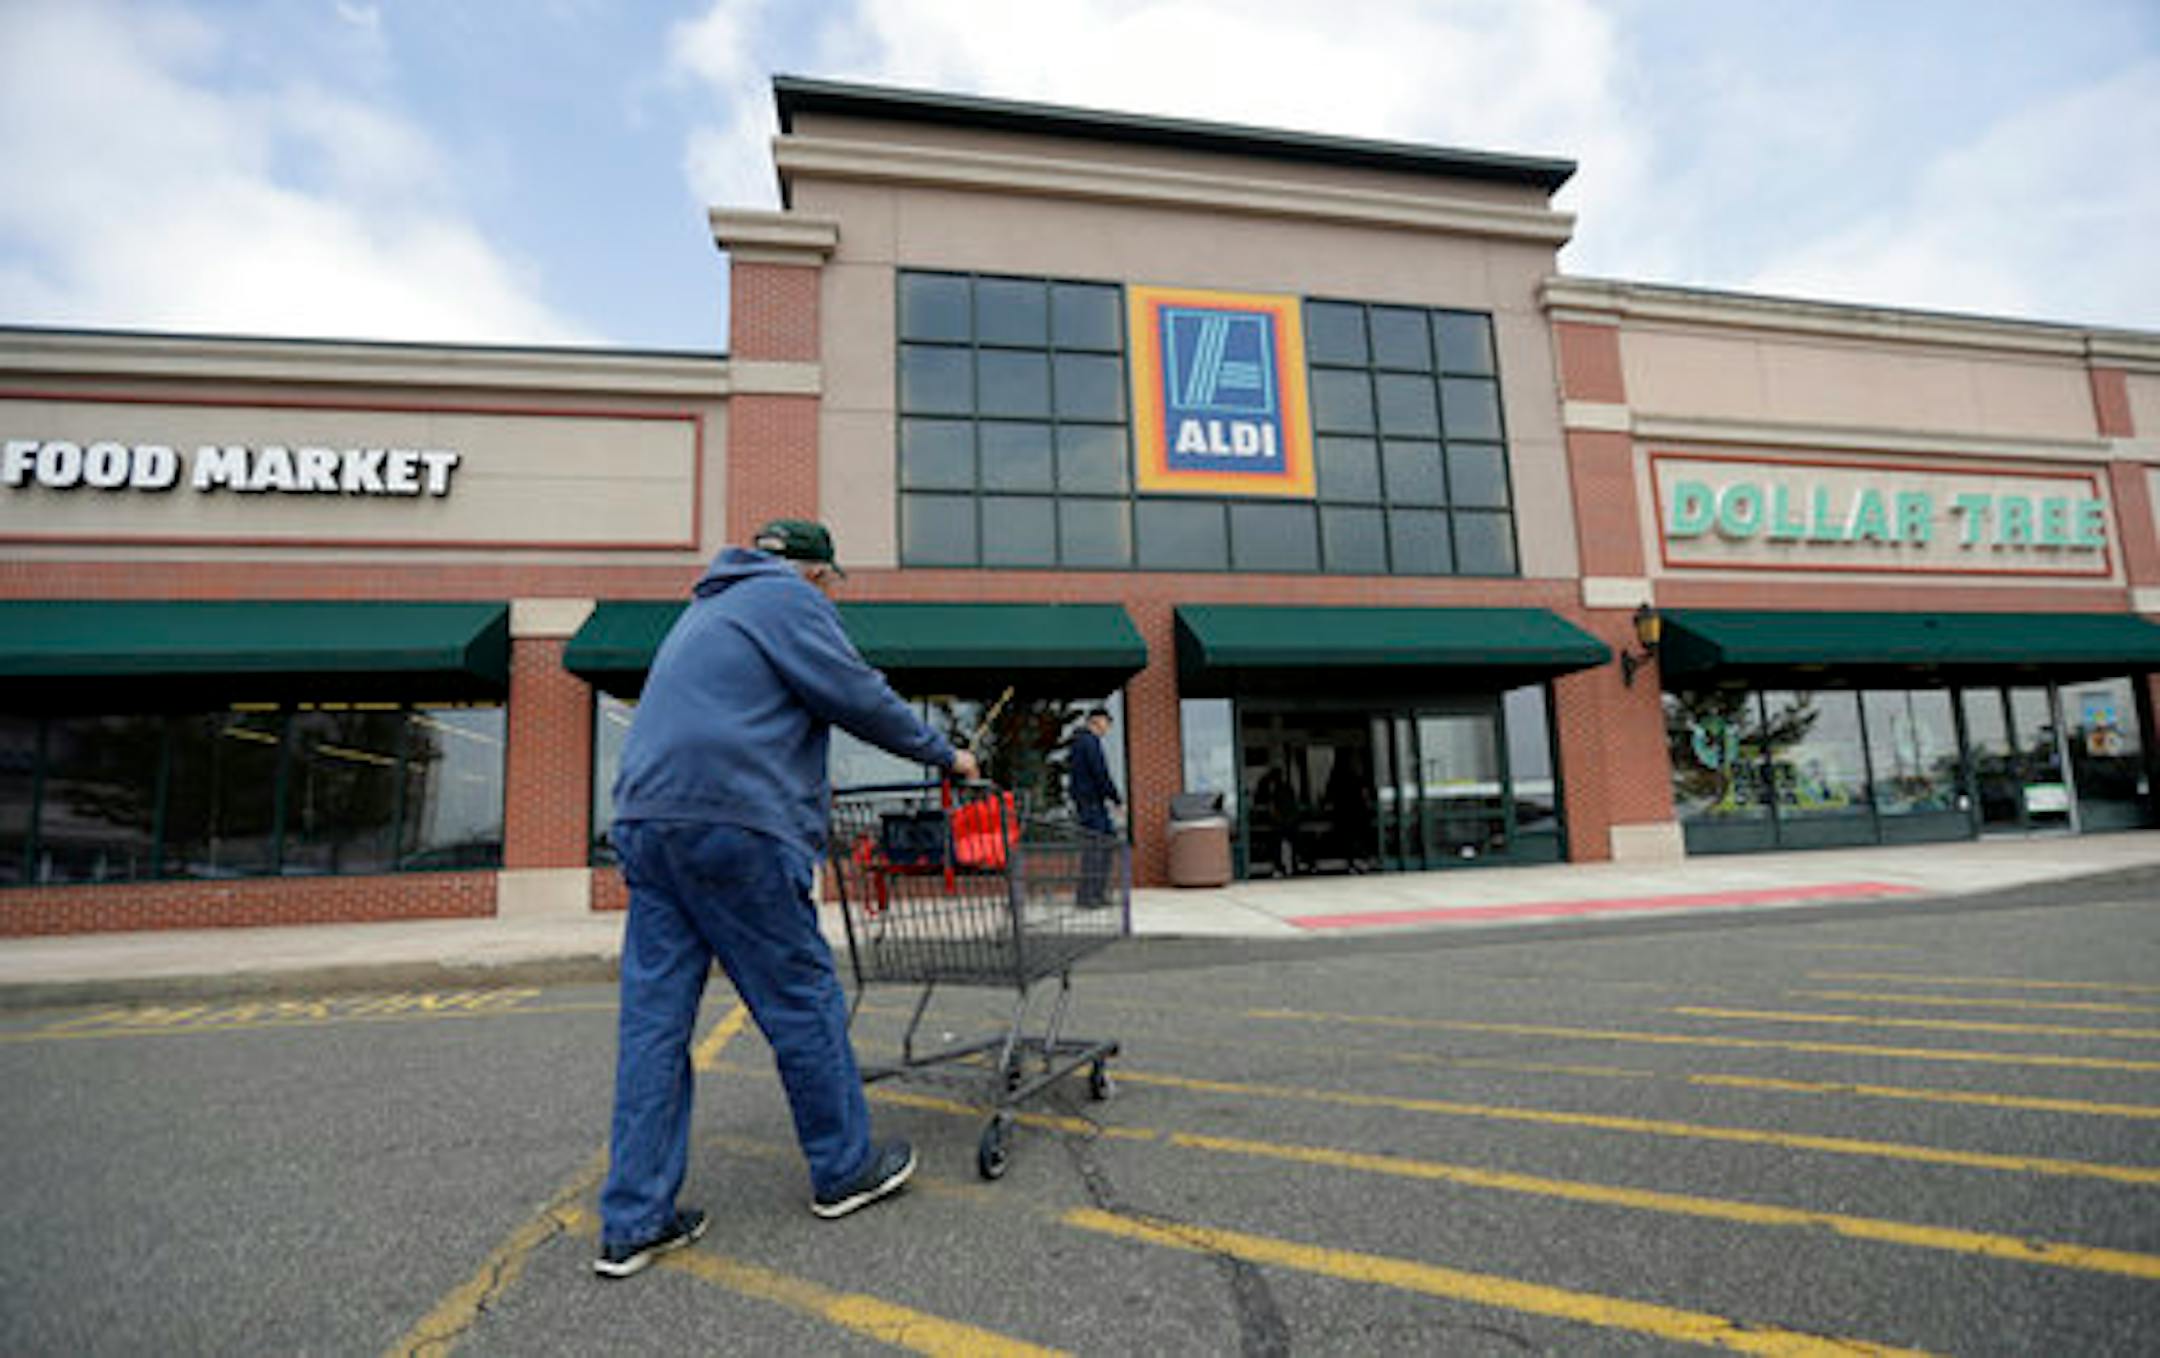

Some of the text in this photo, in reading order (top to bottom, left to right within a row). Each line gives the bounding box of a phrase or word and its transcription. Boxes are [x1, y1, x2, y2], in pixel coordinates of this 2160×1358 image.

[1176, 419, 1276, 457] ALDI
[2, 441, 460, 497] FOOD MARKET
[1670, 480, 2106, 547] DOLLAR TREE
